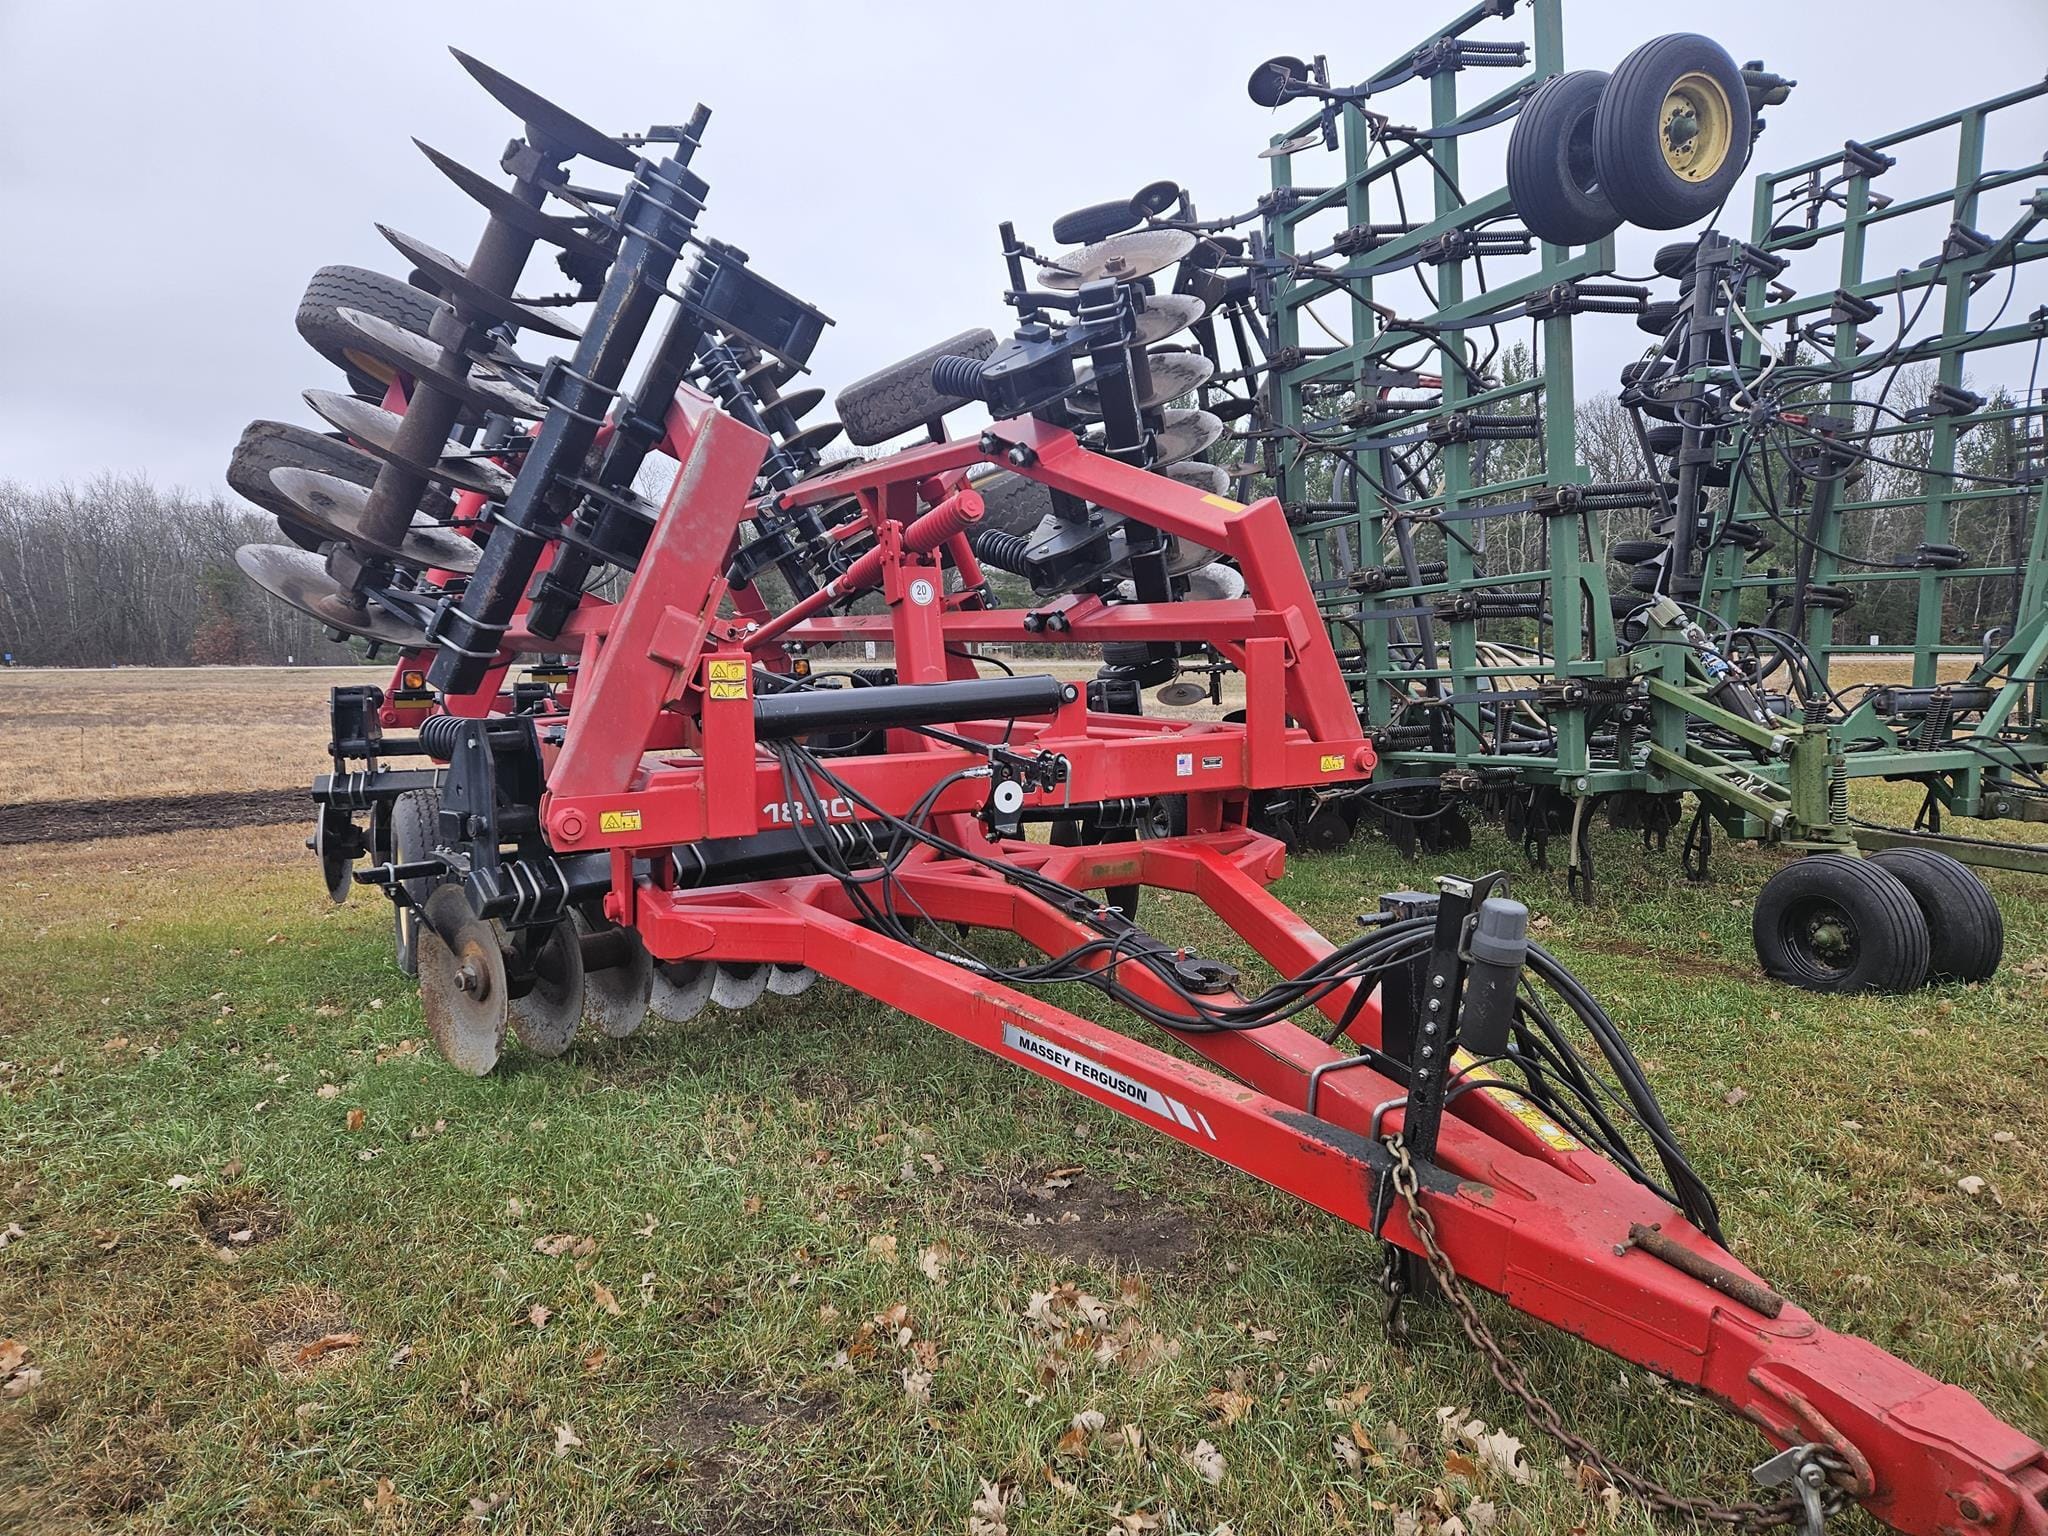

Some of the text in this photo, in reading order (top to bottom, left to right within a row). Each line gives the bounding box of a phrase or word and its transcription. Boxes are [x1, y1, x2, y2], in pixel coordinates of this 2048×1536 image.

[916, 584, 927, 595] 20
[1019, 1036, 1148, 1104] MASSEY FERGUSON
